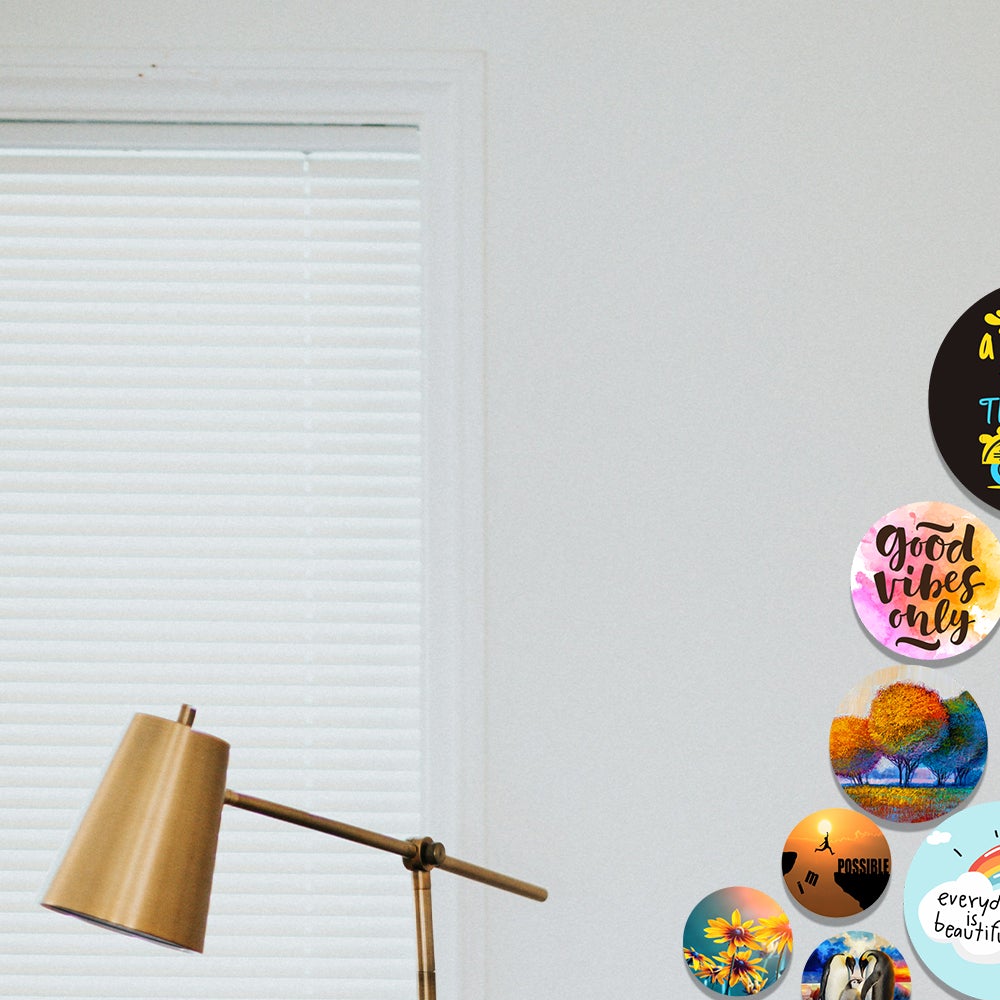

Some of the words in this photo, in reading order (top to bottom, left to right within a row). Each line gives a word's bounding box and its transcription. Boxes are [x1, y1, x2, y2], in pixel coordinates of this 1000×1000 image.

[978, 332, 995, 360] a
[875, 523, 975, 572] good
[873, 563, 985, 604] vibes
[888, 598, 976, 646] only
[837, 858, 890, 875] POSSIBLE
[966, 910, 978, 927] is
